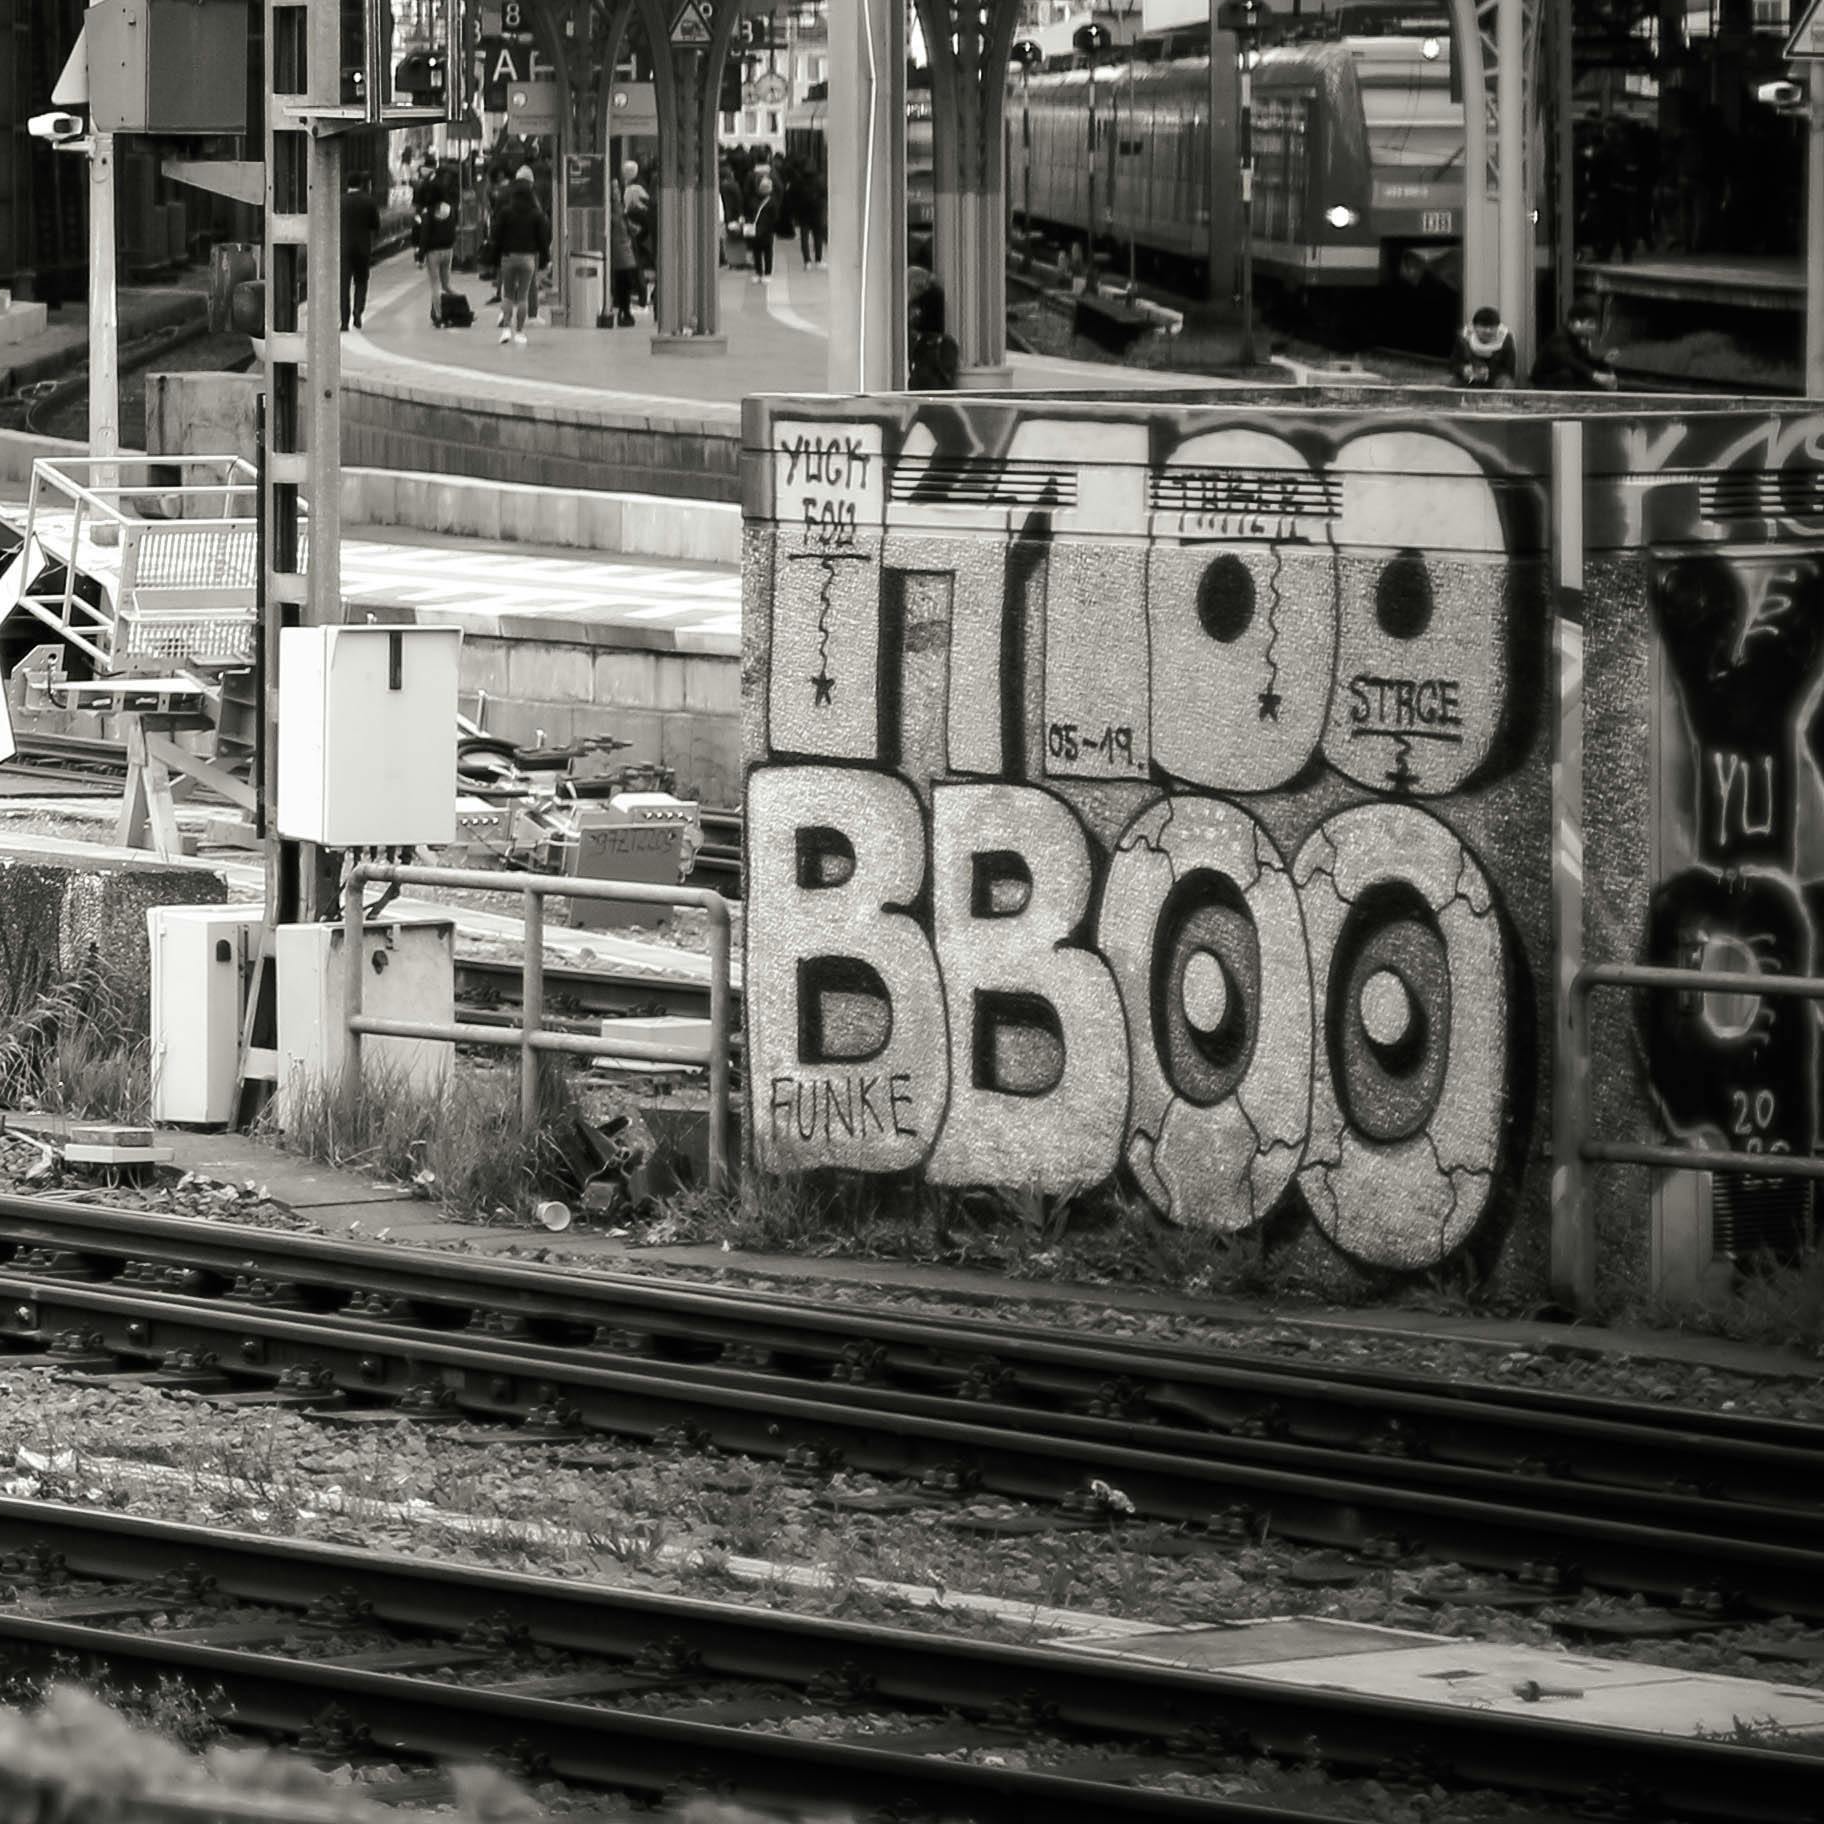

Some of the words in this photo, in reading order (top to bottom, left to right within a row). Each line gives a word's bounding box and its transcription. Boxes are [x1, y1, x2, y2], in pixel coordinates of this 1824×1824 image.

[505, 3, 521, 26] 8
[492, 49, 518, 82] A
[781, 434, 871, 490] YUCK
[770, 1073, 918, 1143] FUNKE
[1733, 1088, 1775, 1135] 20
